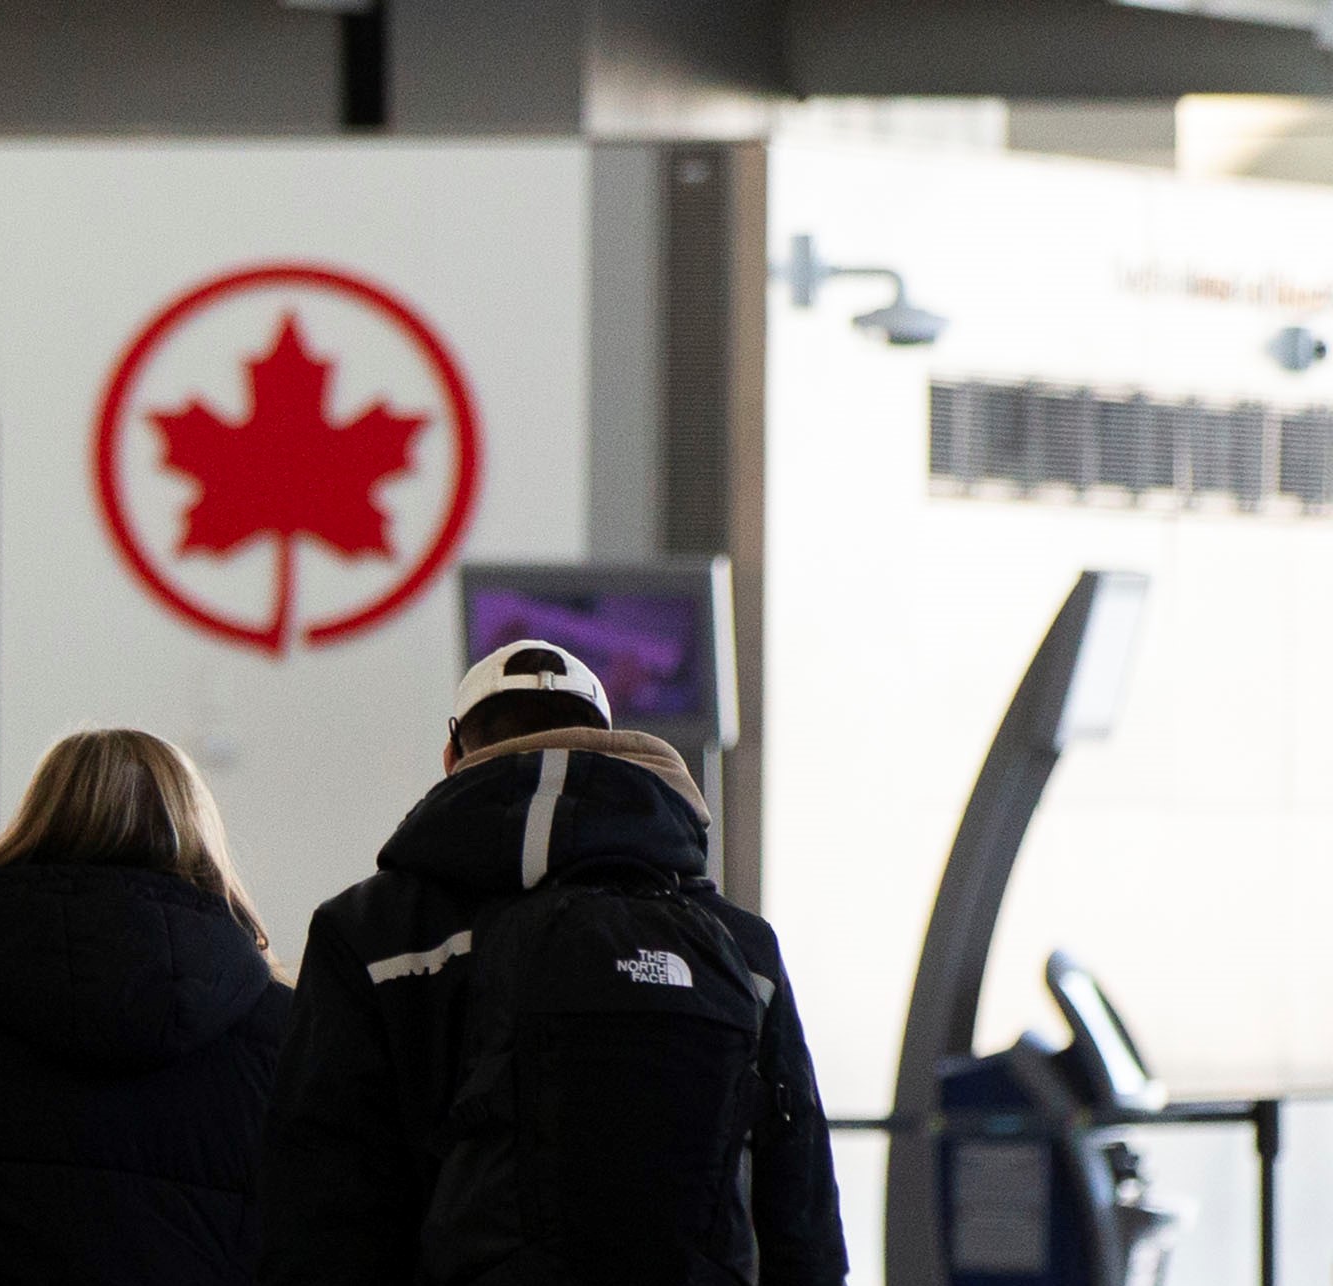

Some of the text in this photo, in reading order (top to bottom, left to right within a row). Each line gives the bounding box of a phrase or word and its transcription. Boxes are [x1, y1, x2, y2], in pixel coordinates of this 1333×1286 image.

[637, 949, 668, 963] THE
[616, 960, 668, 974] NORTH
[631, 971, 668, 984] FACE
